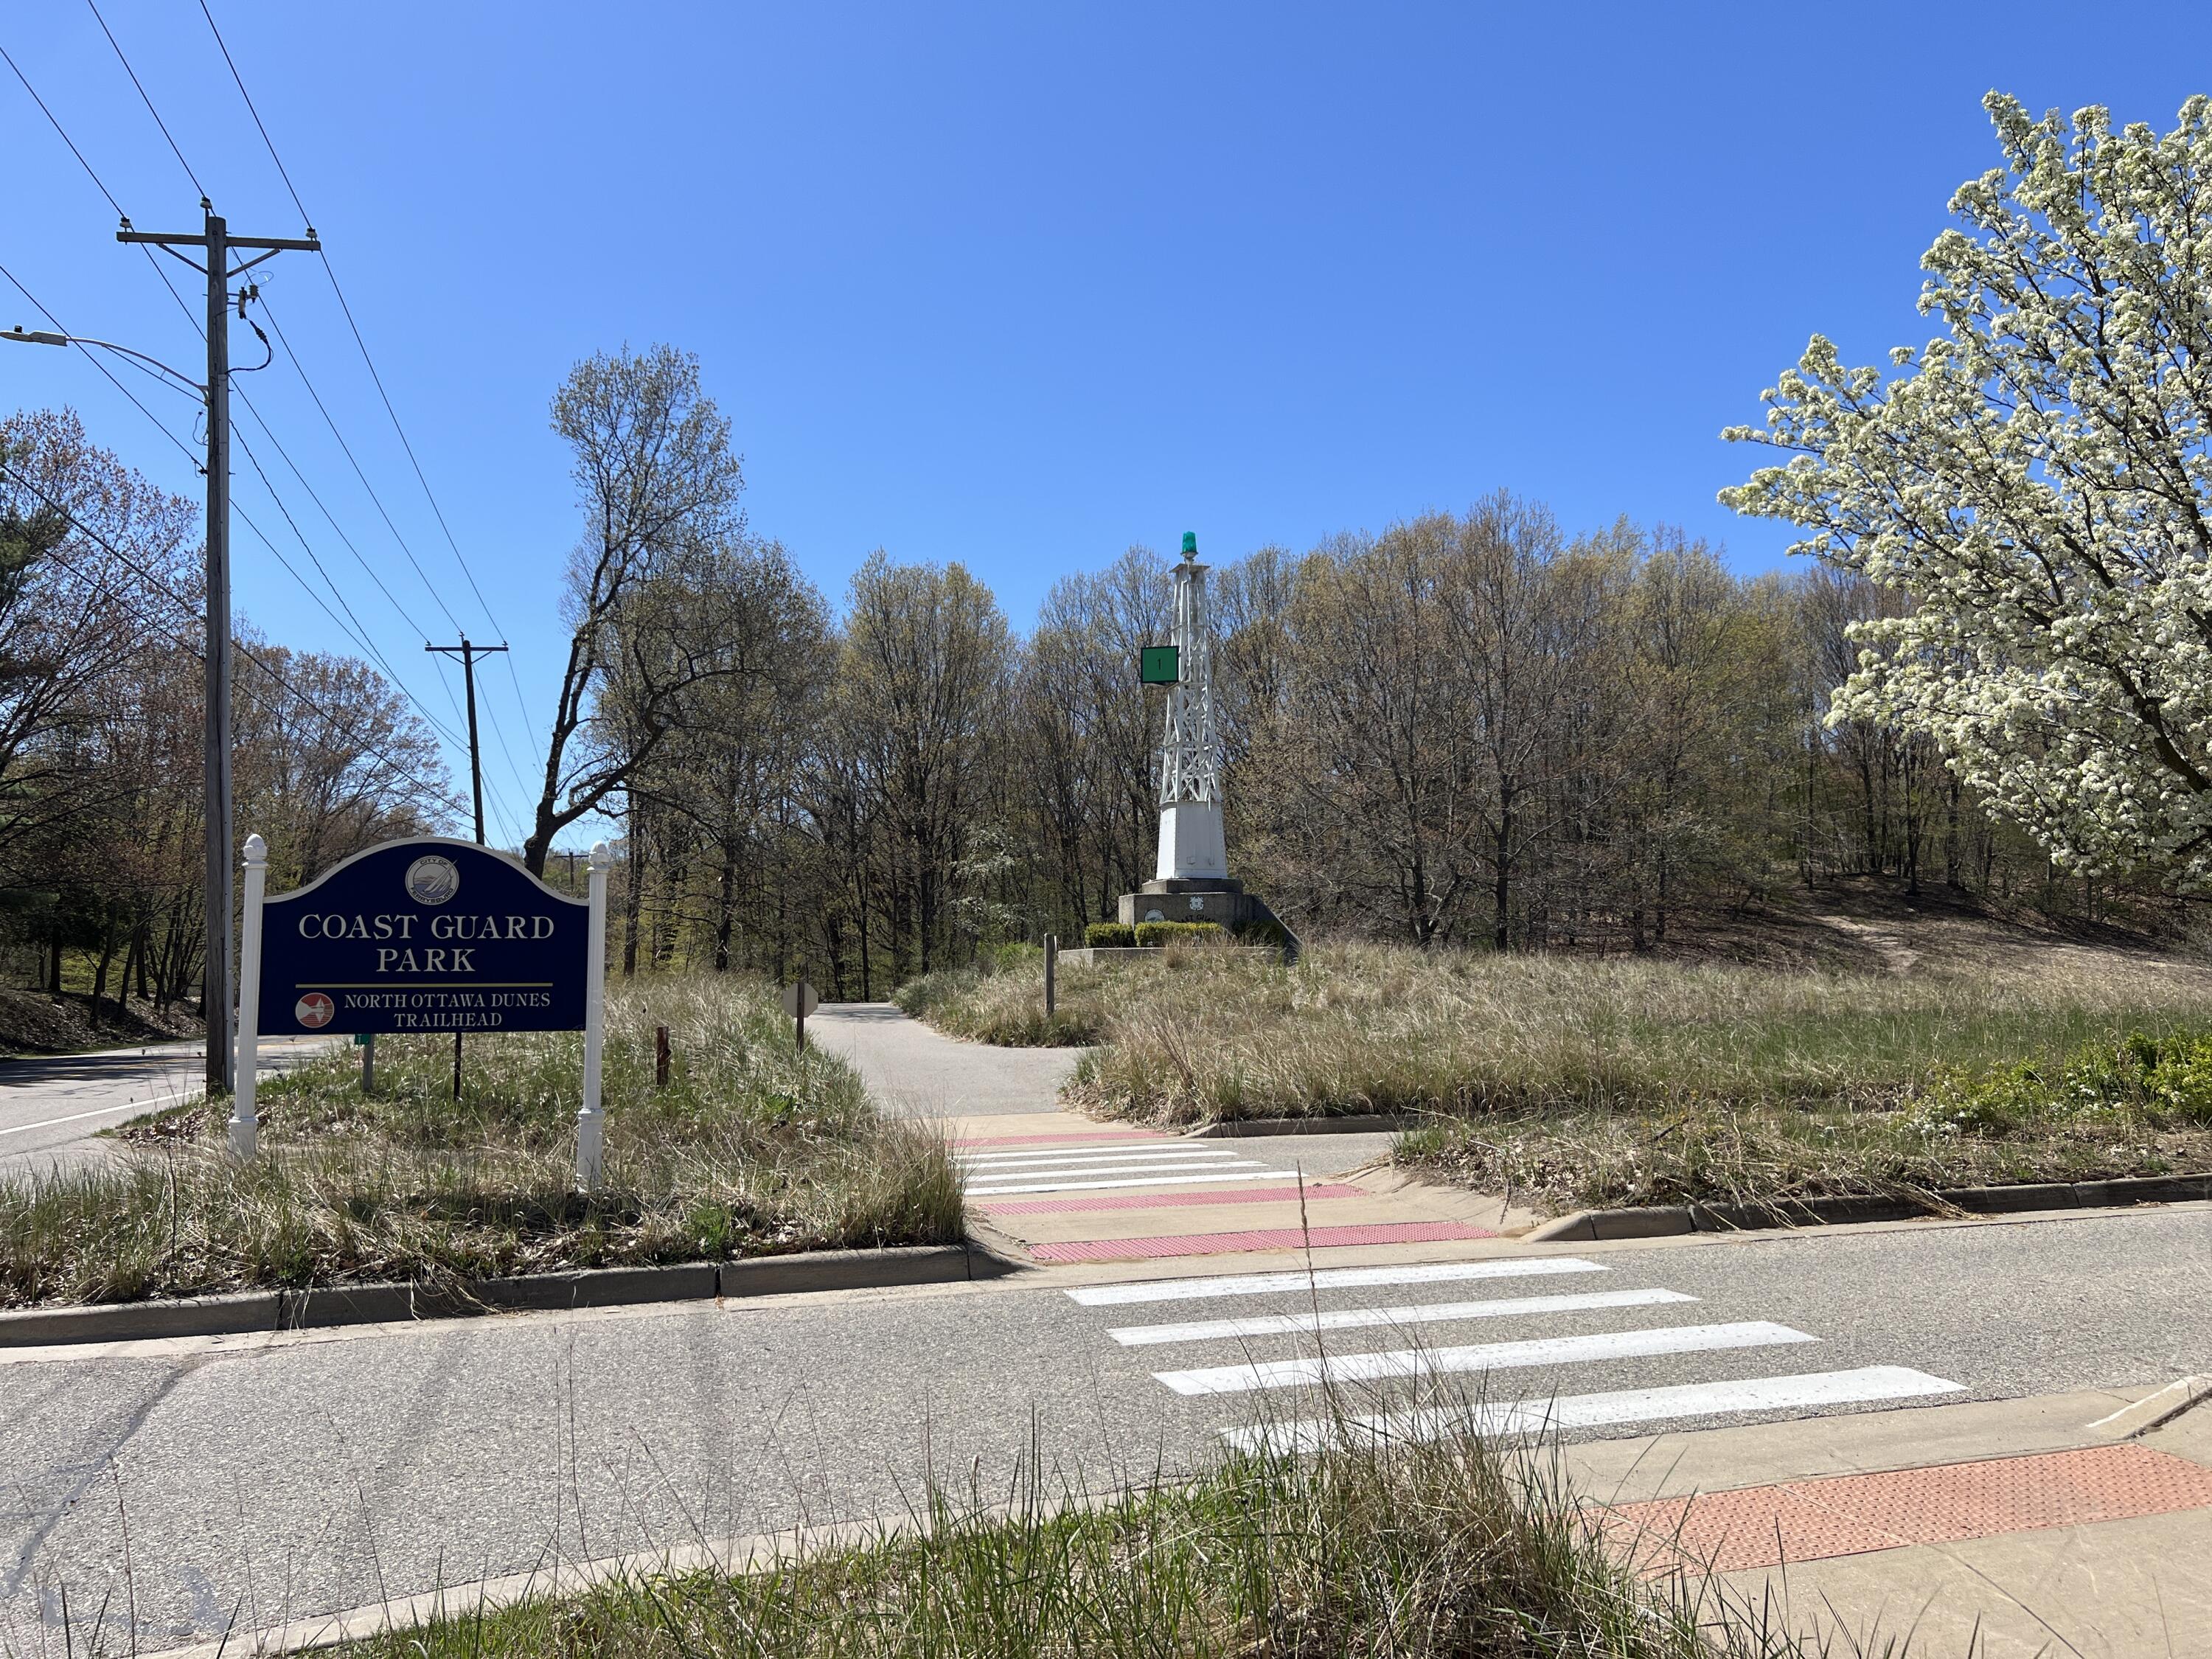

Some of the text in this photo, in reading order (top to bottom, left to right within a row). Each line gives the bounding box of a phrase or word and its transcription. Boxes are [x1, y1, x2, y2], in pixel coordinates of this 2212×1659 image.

[1158, 658, 1161, 670] 1
[299, 914, 554, 940] COAST GUARD
[376, 948, 476, 972] PARK
[344, 992, 551, 1009] NORTH OTTAWA DUNES
[394, 1012, 502, 1027] TRAILHEAD
